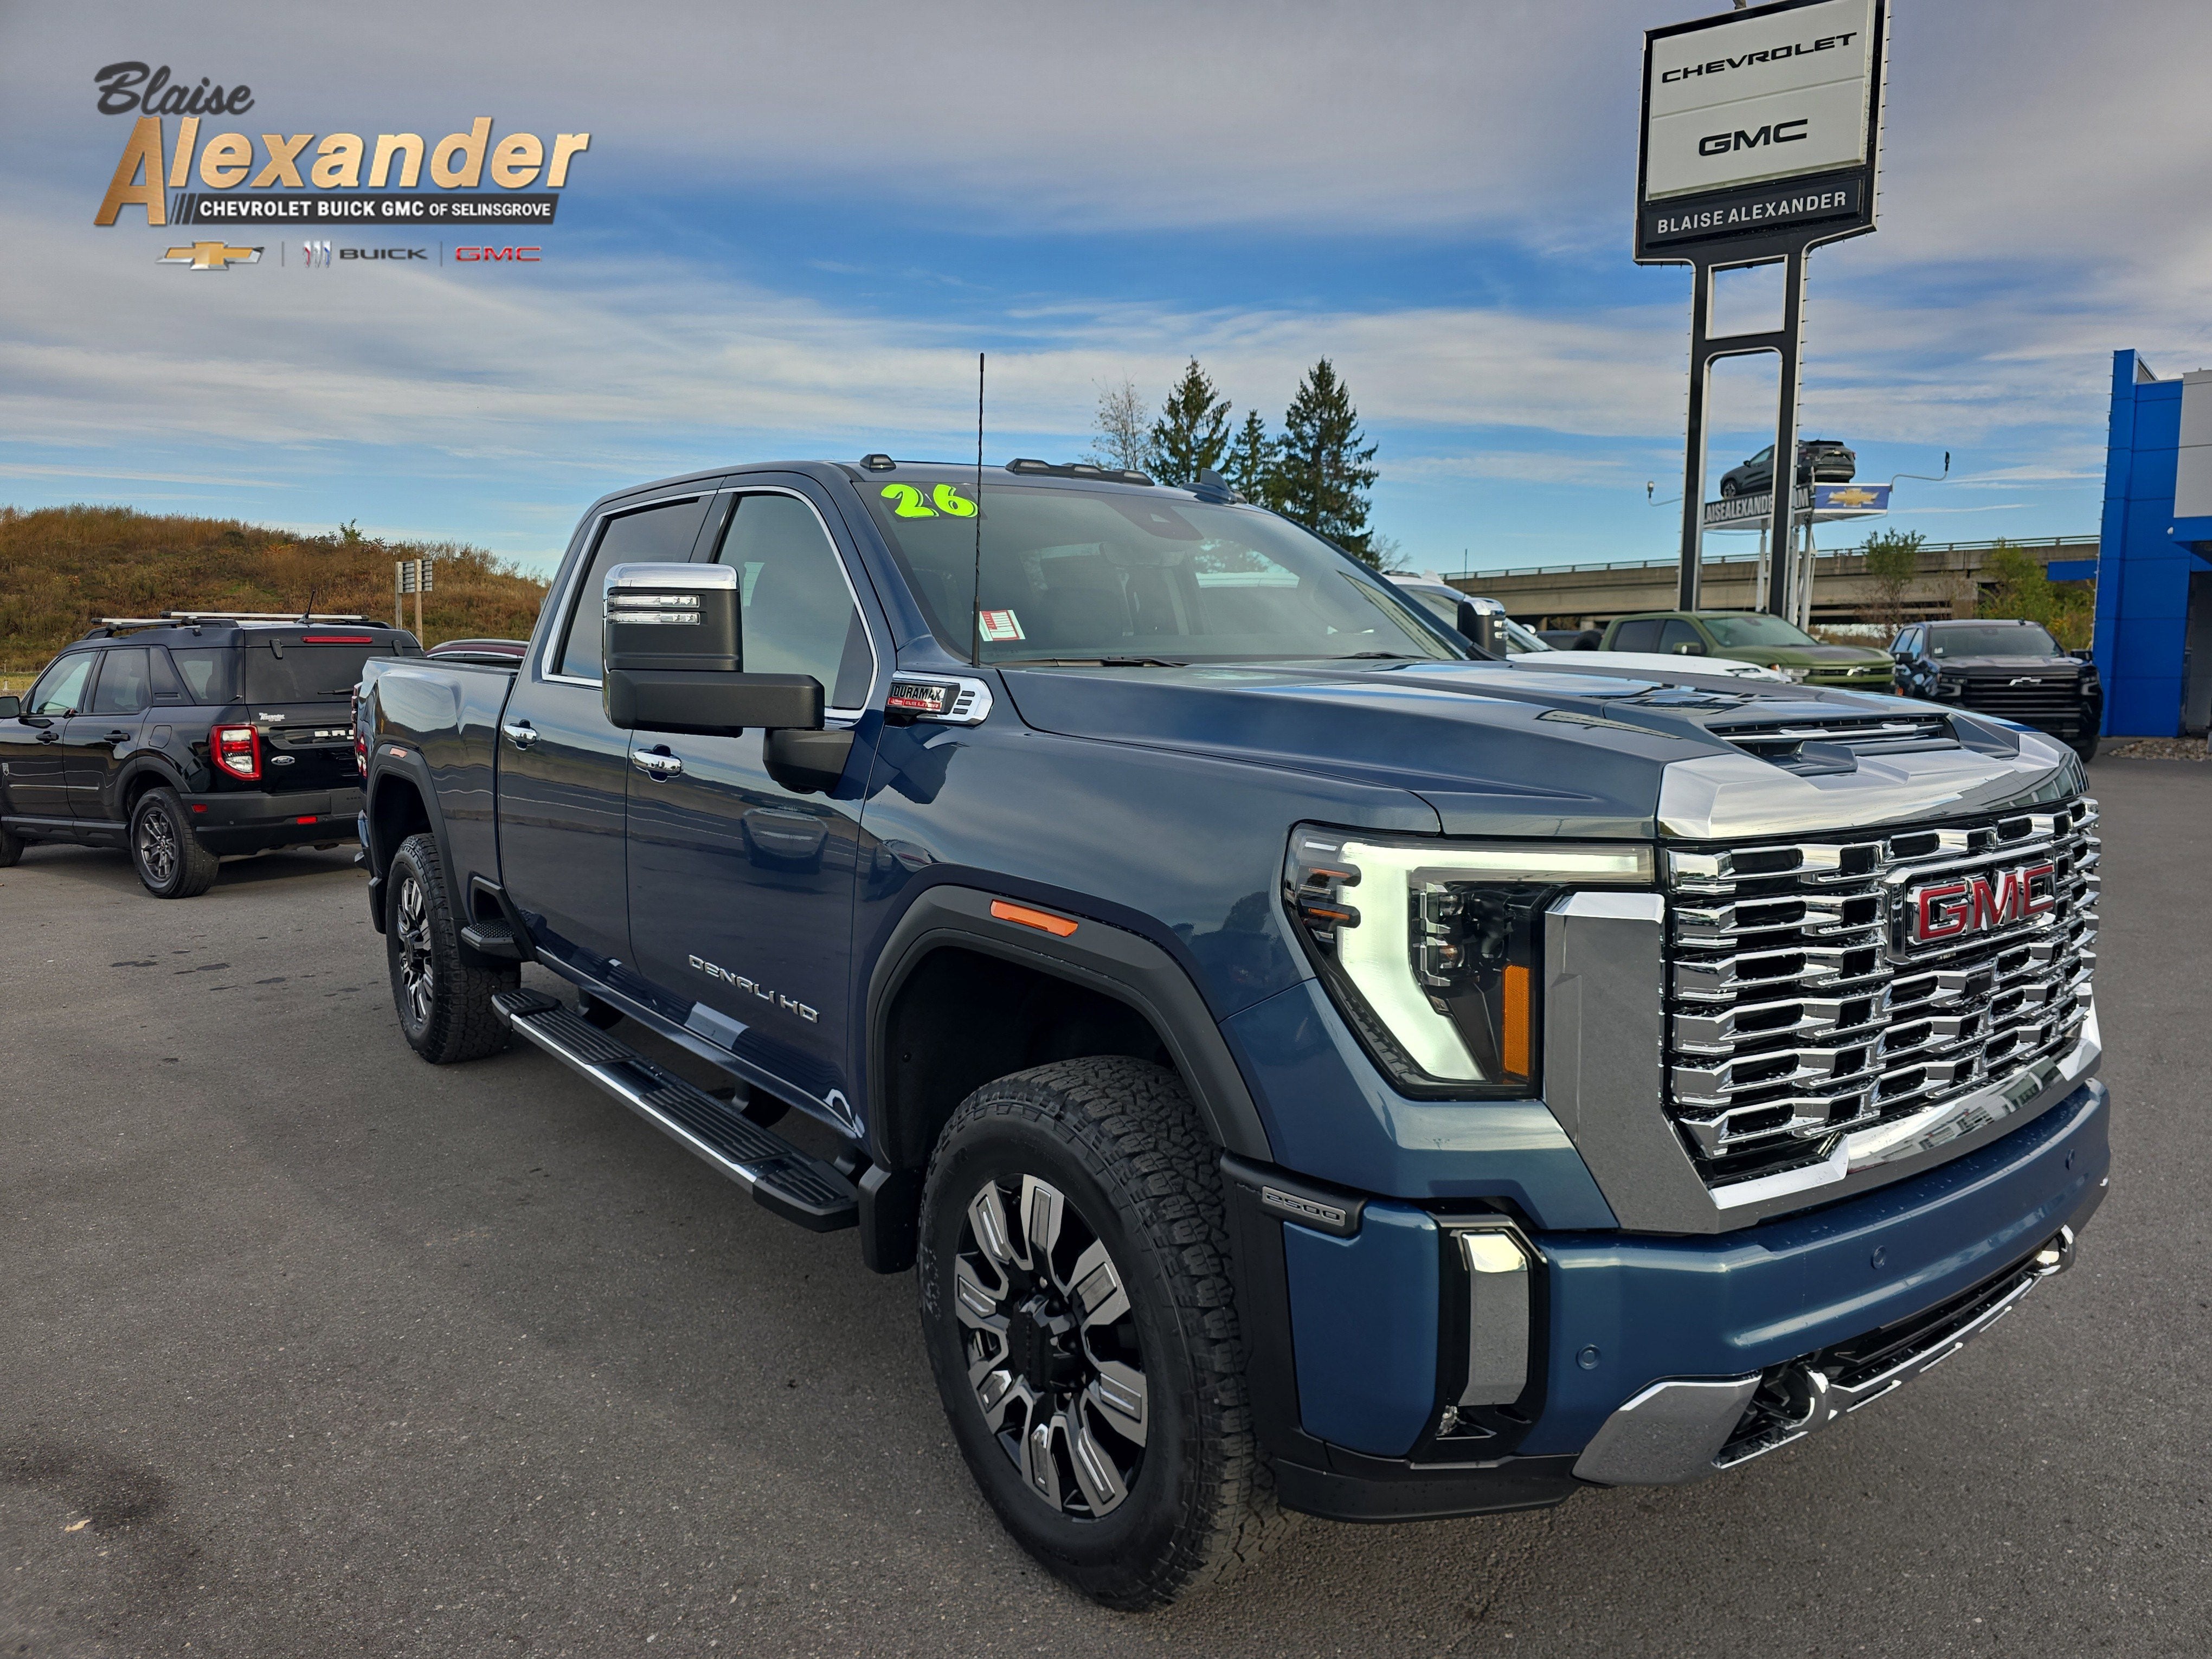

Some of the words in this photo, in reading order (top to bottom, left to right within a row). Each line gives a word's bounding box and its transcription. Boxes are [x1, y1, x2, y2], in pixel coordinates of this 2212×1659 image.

[1662, 32, 1857, 83] CHEVROLET
[1699, 118, 1808, 156] GMC
[1657, 210, 1724, 234] BLAISE
[1727, 191, 1847, 224] ALEXANDER
[880, 484, 978, 518] 26
[893, 685, 942, 701] DURAMAX
[1917, 864, 2055, 941] GMC
[689, 954, 776, 1004] DENALI
[780, 994, 820, 1024] HD
[1265, 1192, 1341, 1222] 2500
